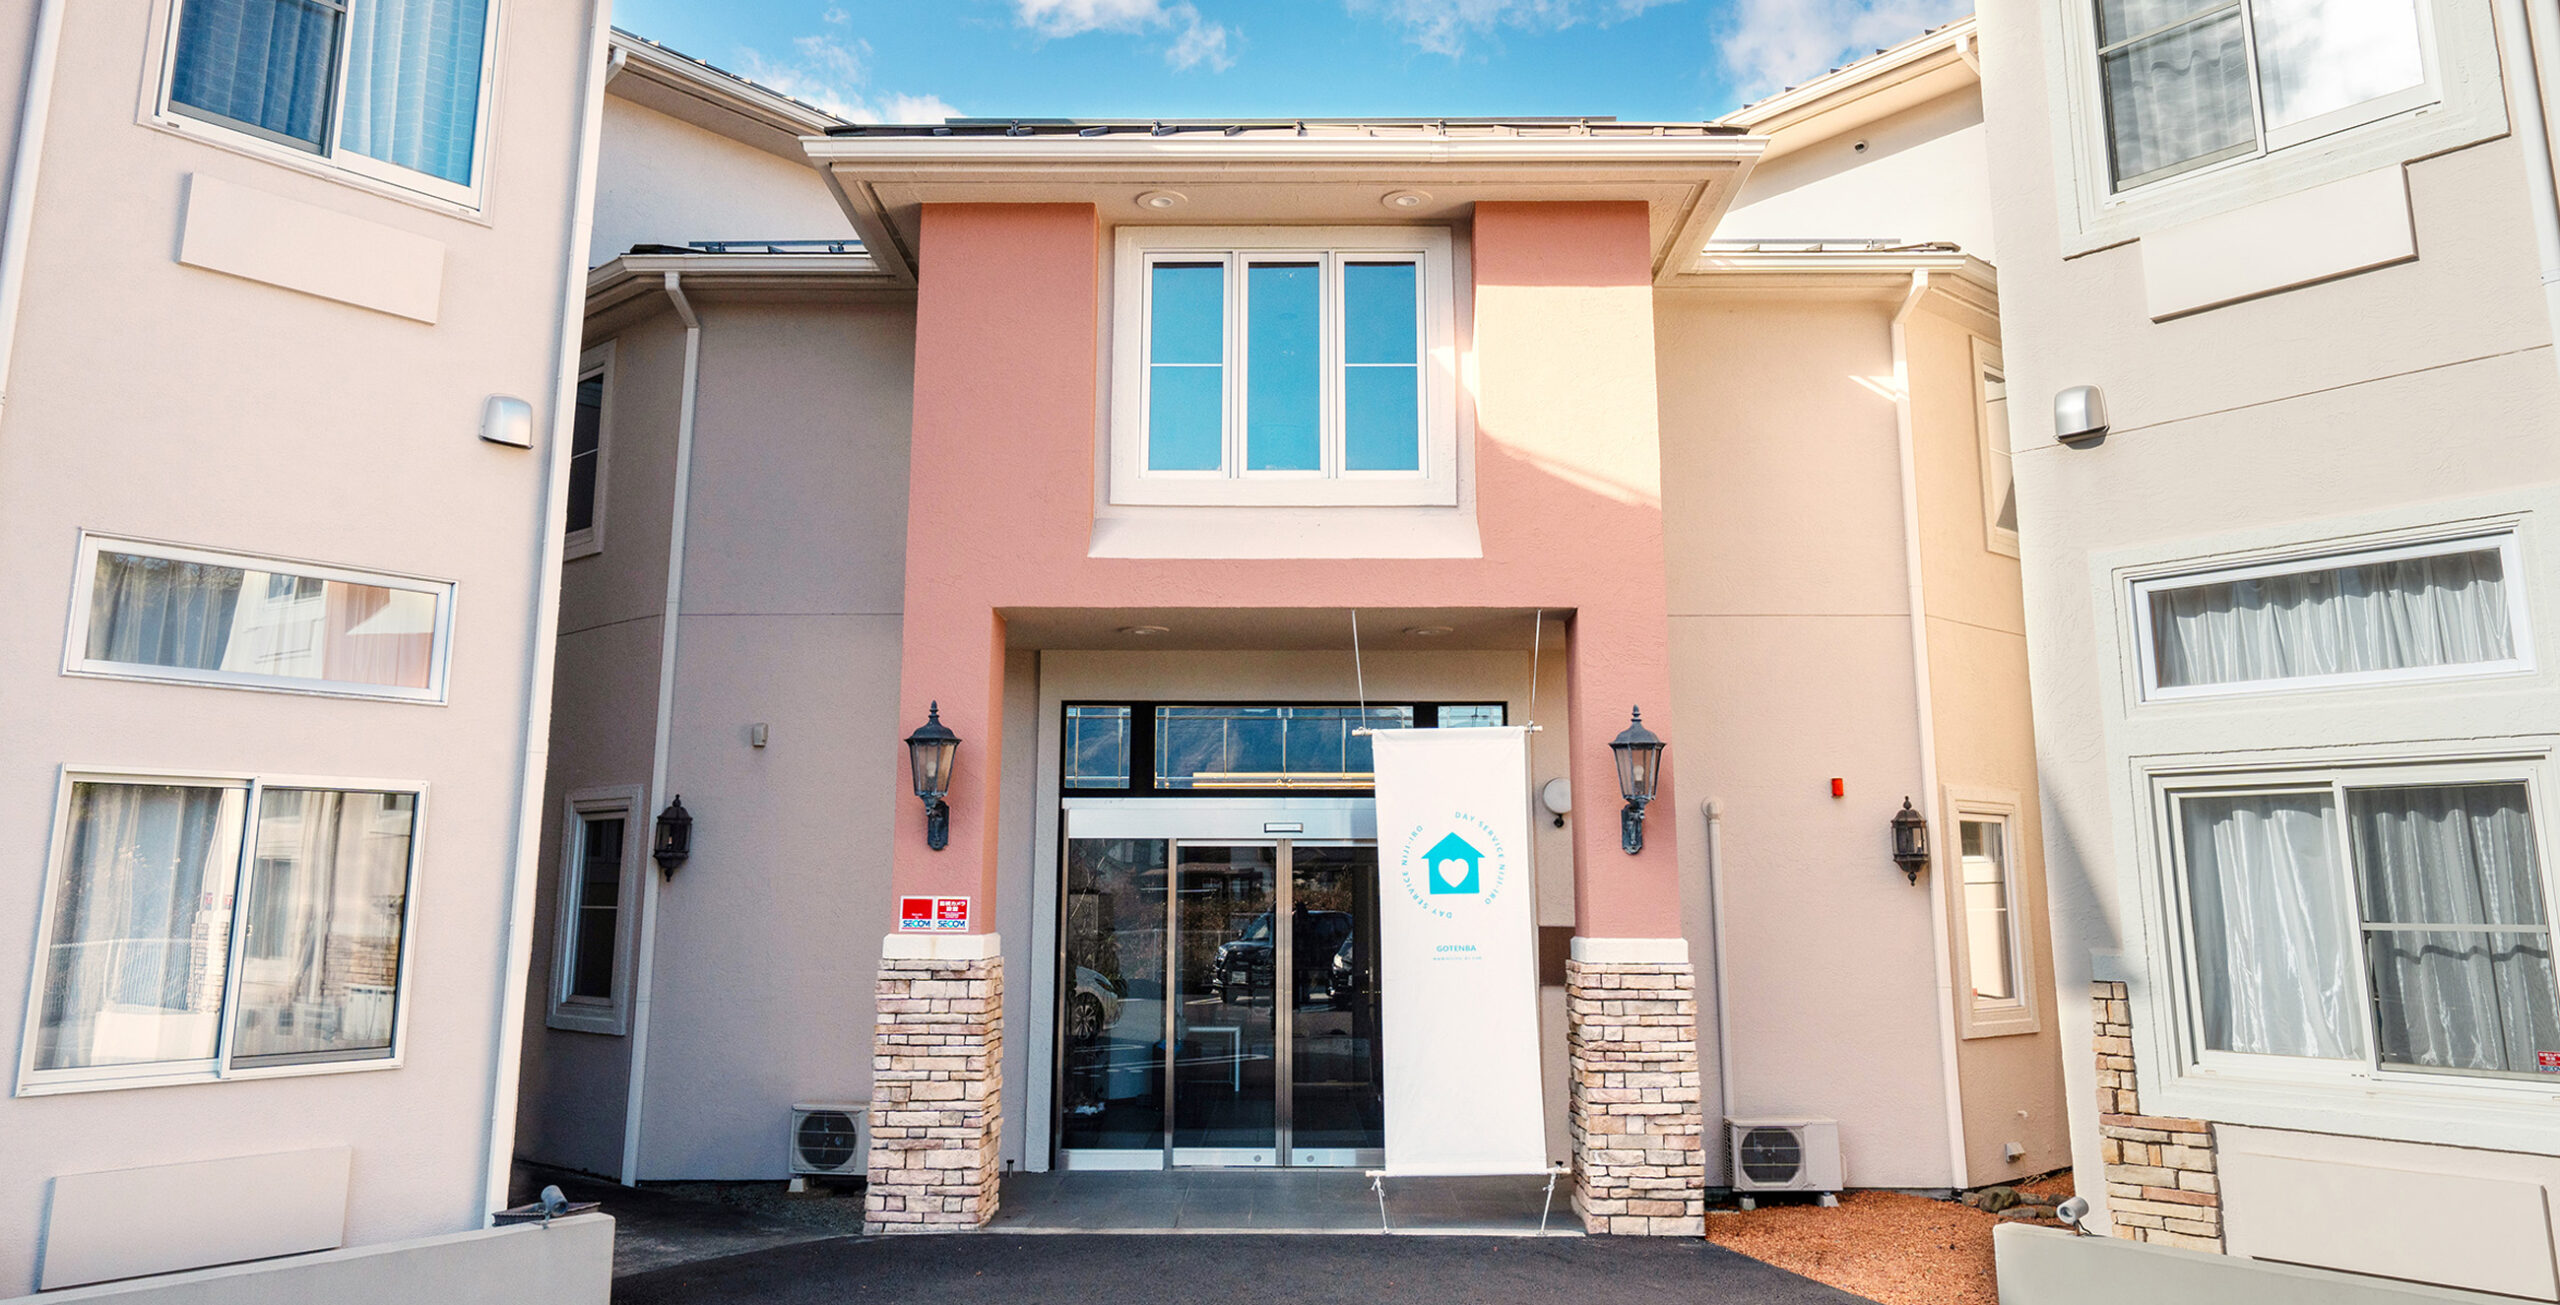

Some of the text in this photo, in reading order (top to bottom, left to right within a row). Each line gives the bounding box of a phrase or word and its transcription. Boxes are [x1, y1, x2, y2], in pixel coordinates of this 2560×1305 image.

[1455, 811, 1475, 821] DAY
[1479, 821, 1504, 858] SERVICE
[1402, 871, 1429, 909] SERVICE
[1432, 908, 1453, 919] DAY
[1436, 945, 1477, 953] GOTENBA
